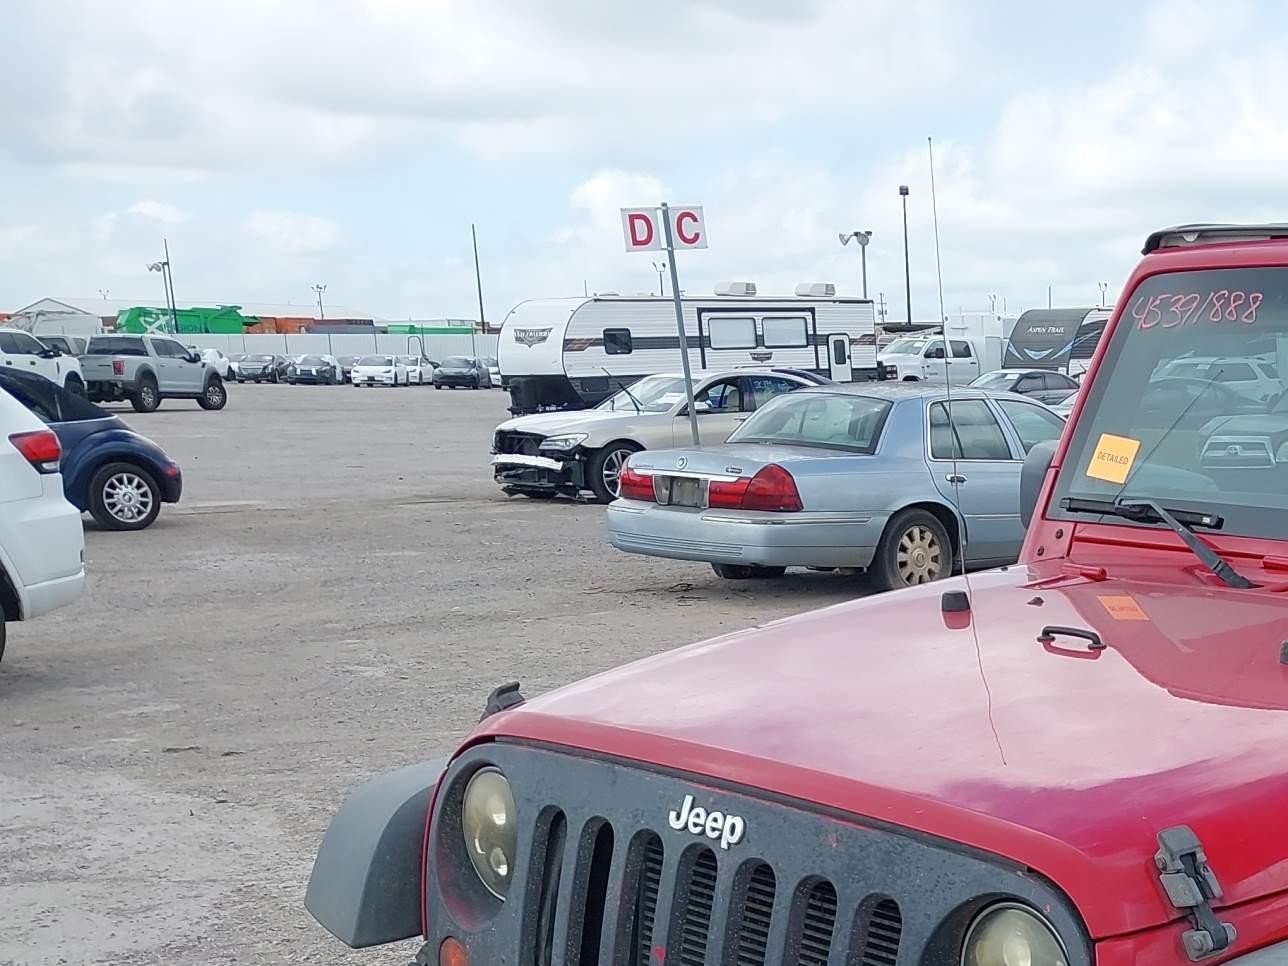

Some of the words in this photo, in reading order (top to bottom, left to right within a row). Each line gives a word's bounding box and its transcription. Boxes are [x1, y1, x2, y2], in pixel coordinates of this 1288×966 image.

[627, 213, 653, 247] D
[676, 211, 701, 245] C
[1131, 290, 1263, 329] 45391888
[1097, 450, 1129, 465] DETAILED
[668, 795, 746, 850] Jeep
